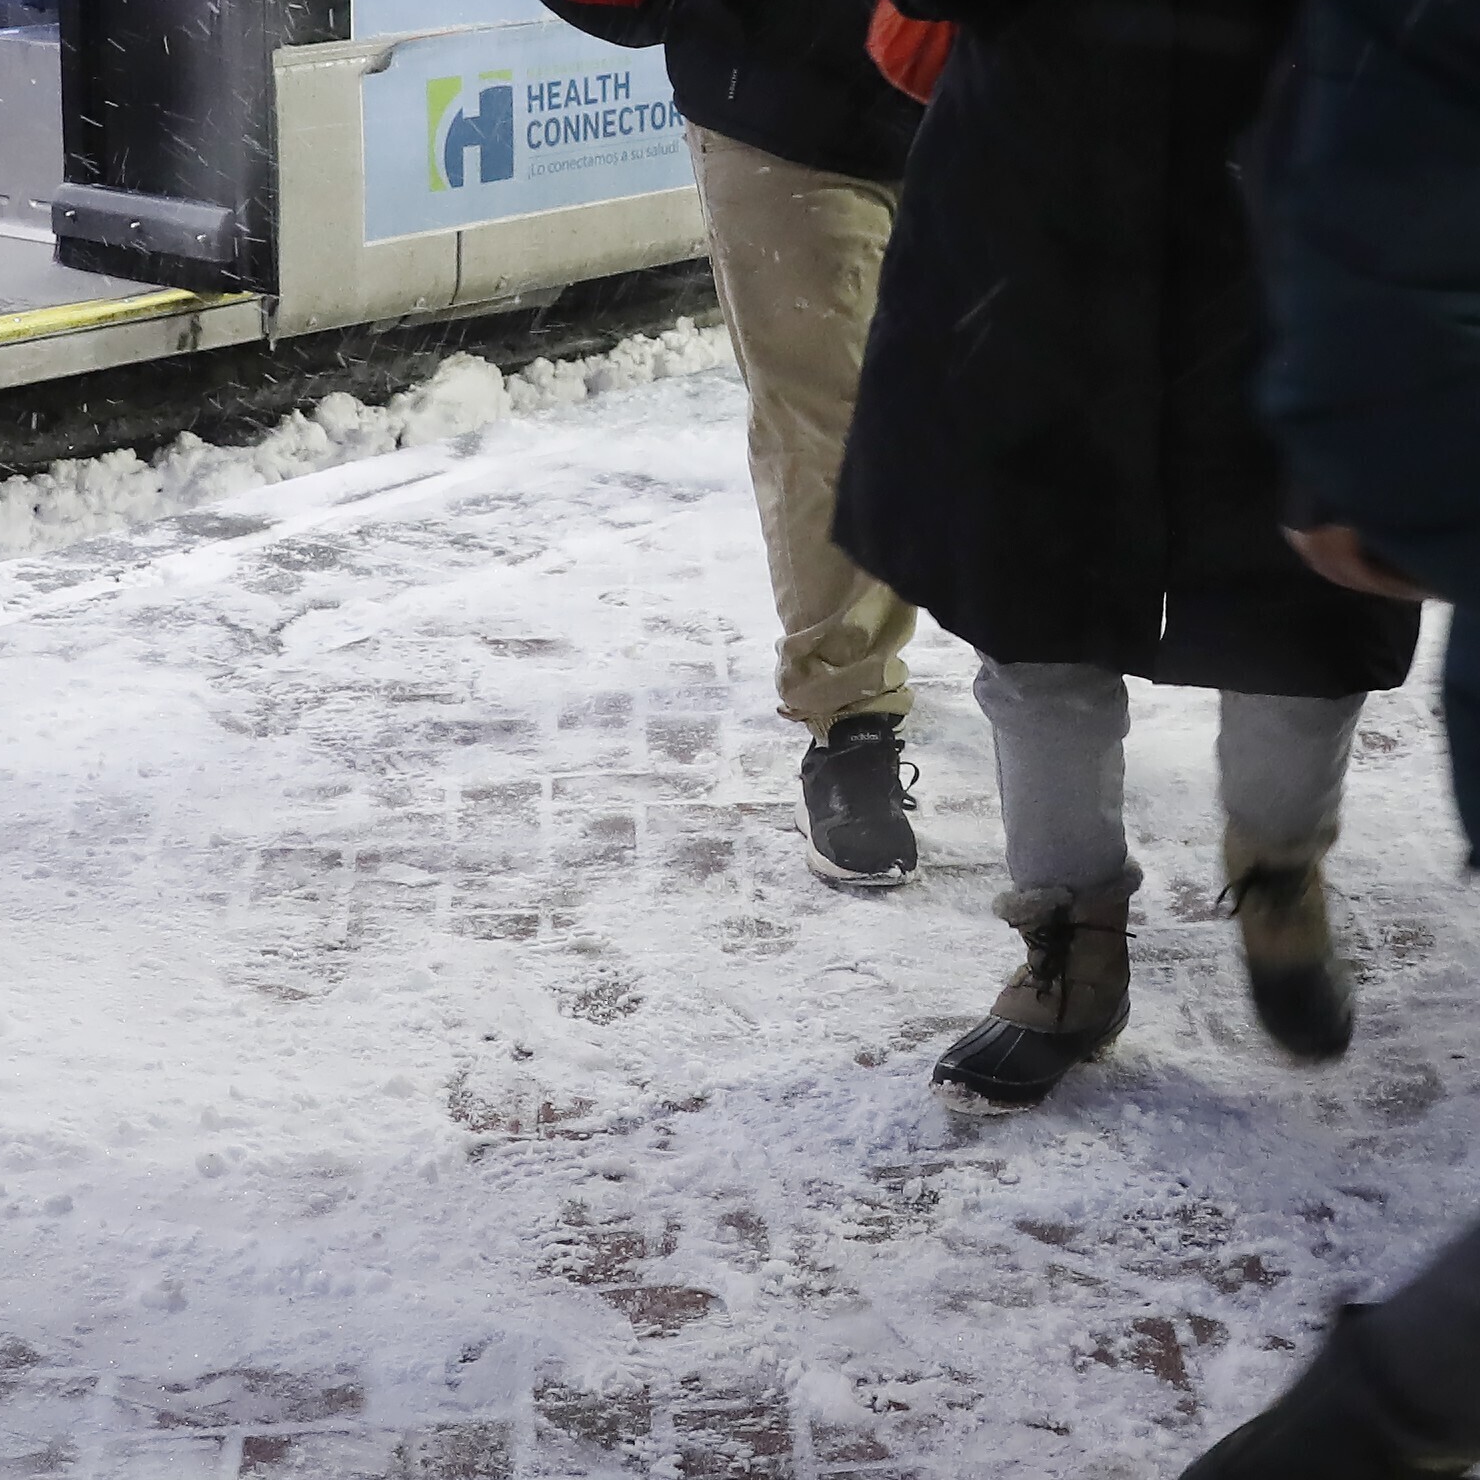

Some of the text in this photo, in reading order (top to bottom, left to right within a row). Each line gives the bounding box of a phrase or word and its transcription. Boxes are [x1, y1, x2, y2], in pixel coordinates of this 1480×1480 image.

[527, 71, 630, 113] HEALTH
[526, 100, 684, 150] CONNECTOR
[549, 153, 619, 174] conectamos
